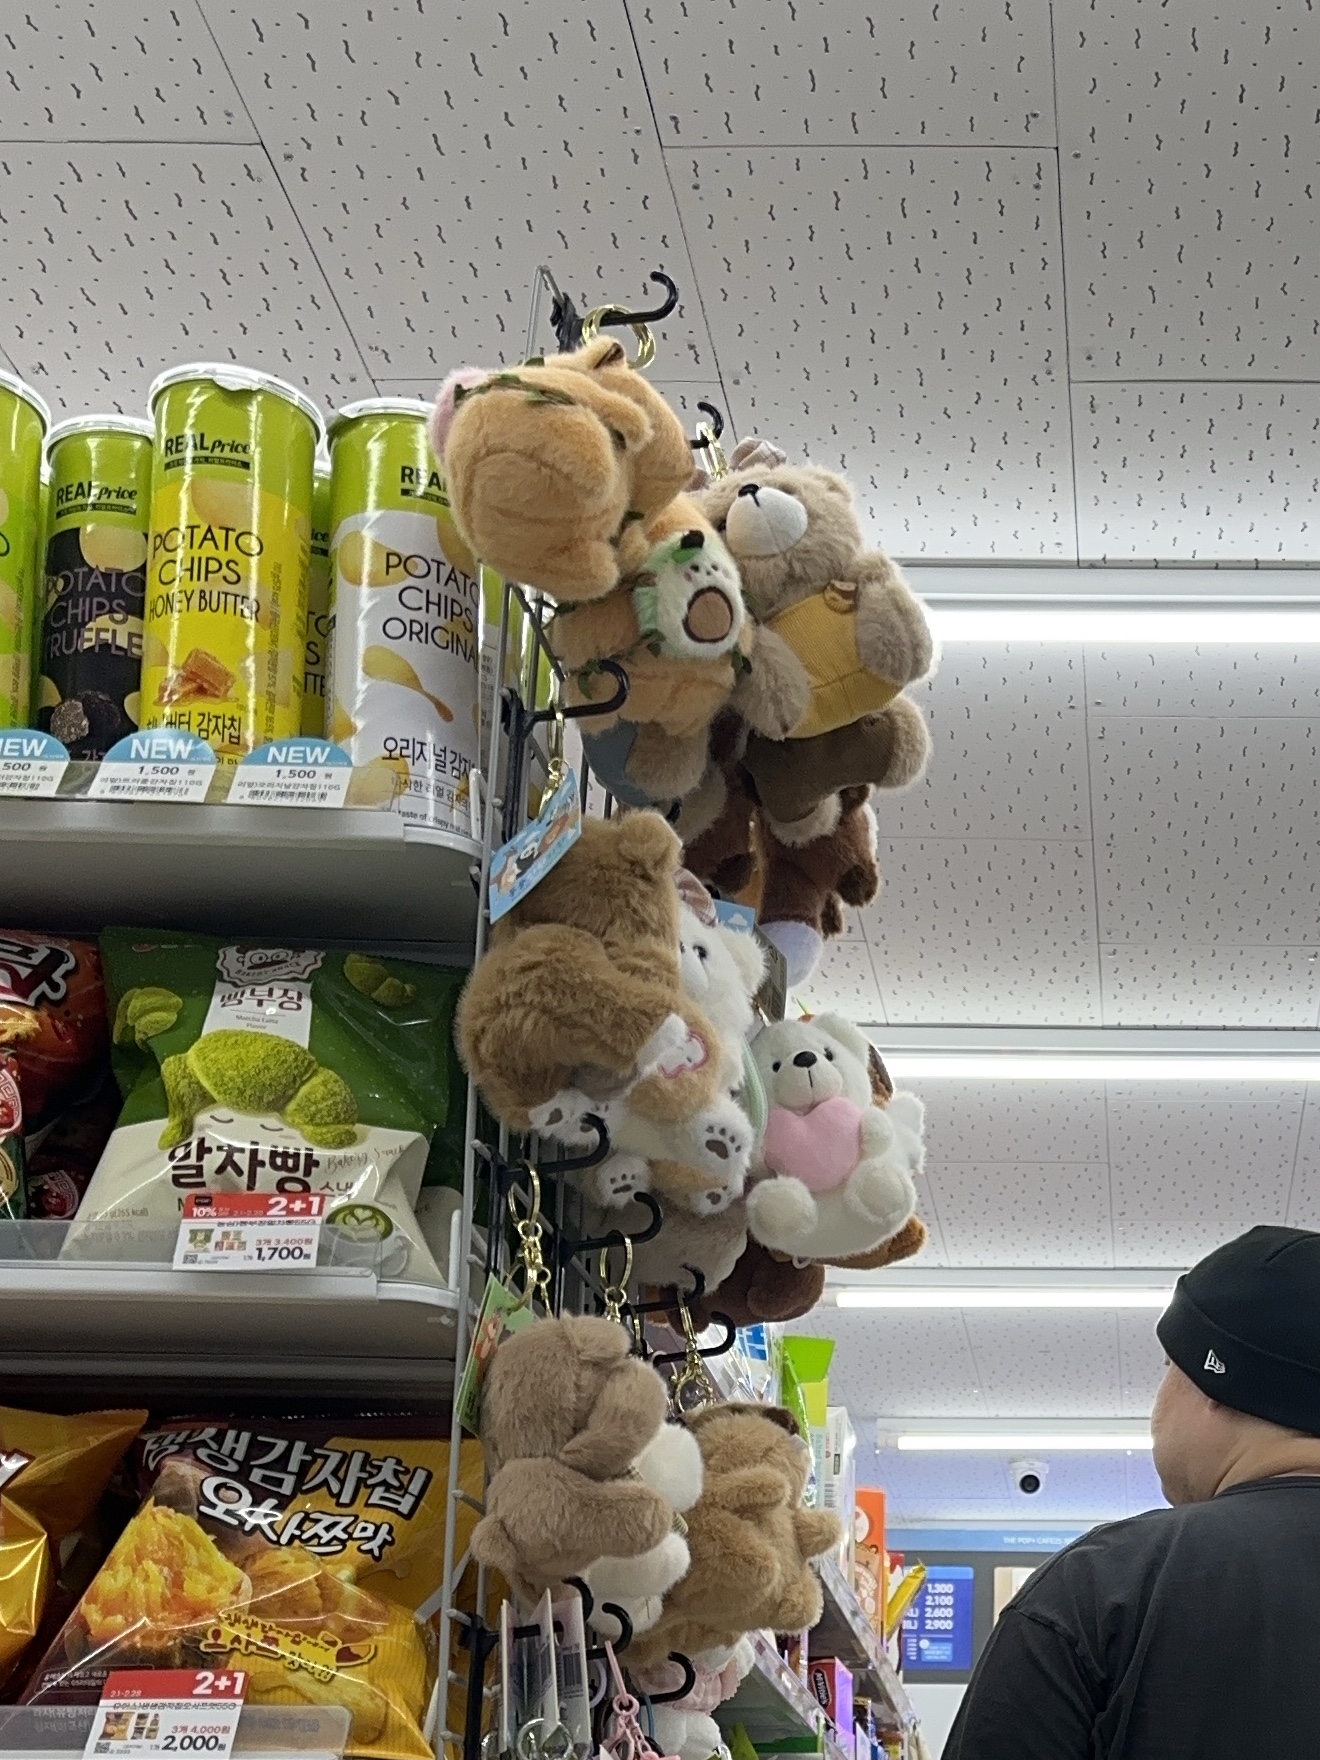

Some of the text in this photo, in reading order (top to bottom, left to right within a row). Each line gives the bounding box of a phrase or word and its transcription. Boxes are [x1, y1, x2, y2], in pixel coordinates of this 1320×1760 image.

[153, 525, 264, 558] POTATO
[159, 556, 241, 586] CHIPS
[50, 597, 128, 627] CHIPS
[149, 590, 260, 623] HONEY BUTTER
[398, 586, 473, 633] CHIPS
[382, 618, 479, 673] ORIGINA
[196, 711, 242, 745] 감자칩
[131, 738, 193, 760] NEW
[267, 746, 330, 764] NEW
[220, 986, 303, 1011] 빵부장
[168, 1137, 320, 1193] 말차빵
[267, 1196, 321, 1216] 2+1
[193, 1671, 245, 1695] 2+1
